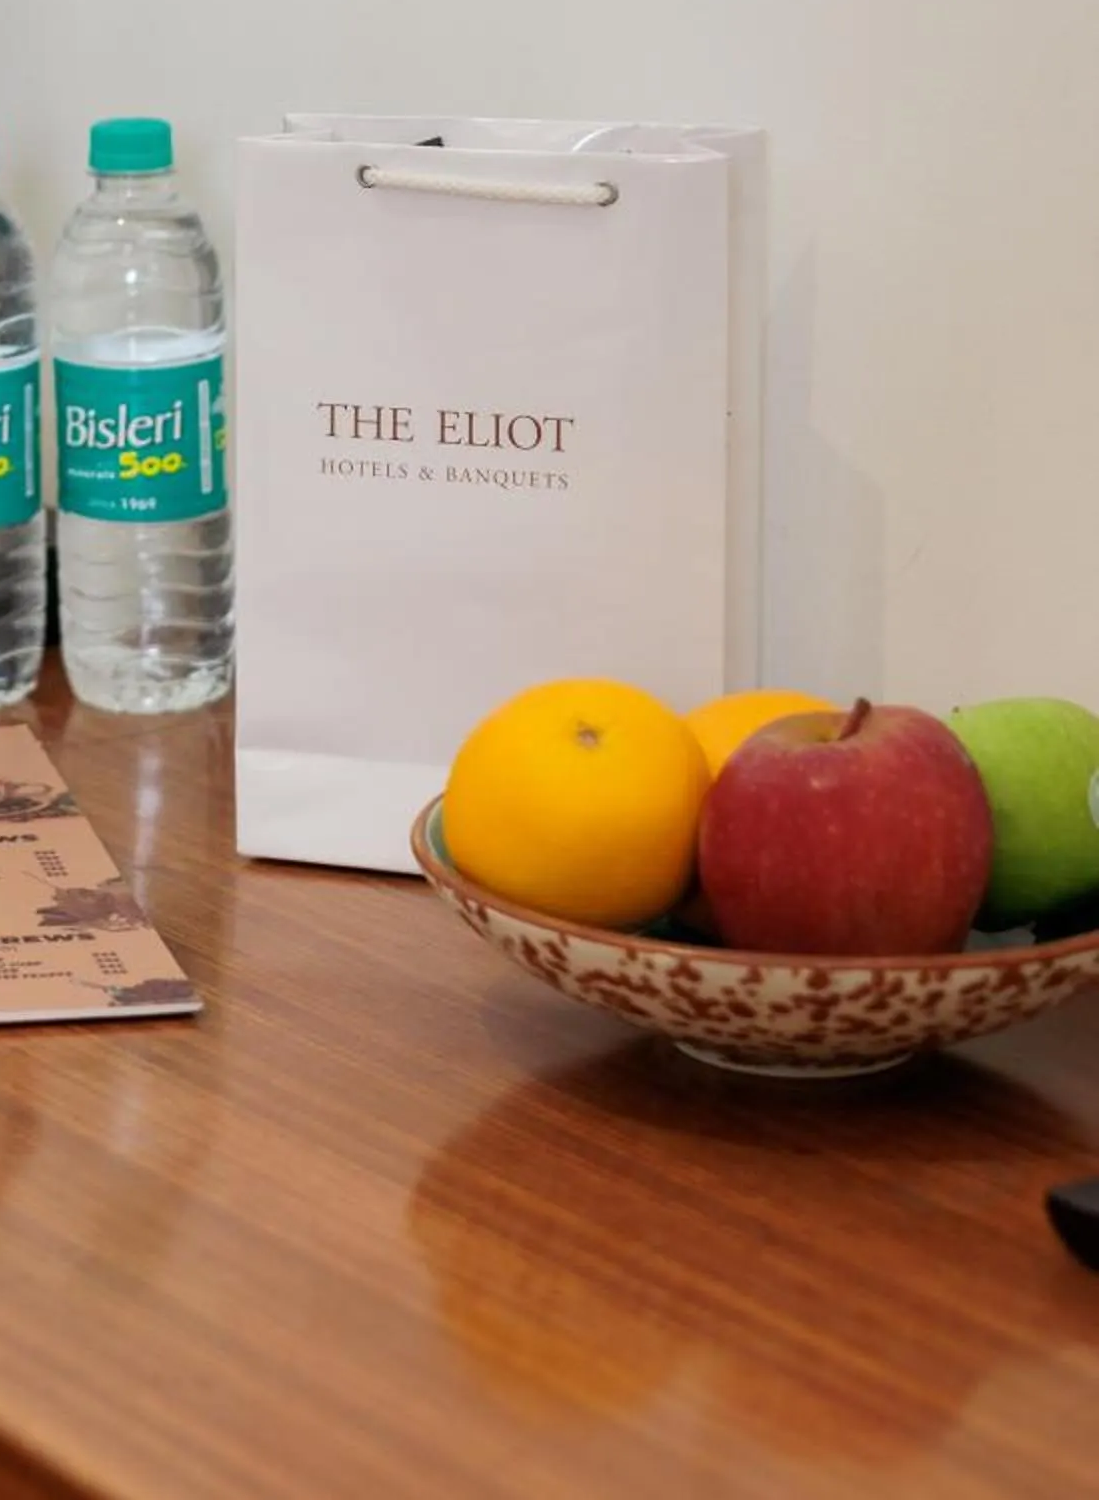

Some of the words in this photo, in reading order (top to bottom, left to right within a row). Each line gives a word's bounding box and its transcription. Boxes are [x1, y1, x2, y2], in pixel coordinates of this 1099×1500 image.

[65, 400, 182, 449] Bisleri
[317, 402, 414, 442] THE
[437, 409, 575, 452] ELIOT
[119, 451, 182, 479] 500
[320, 457, 409, 480] HOTELS
[418, 465, 435, 482] &
[445, 465, 569, 491] BANQUETS
